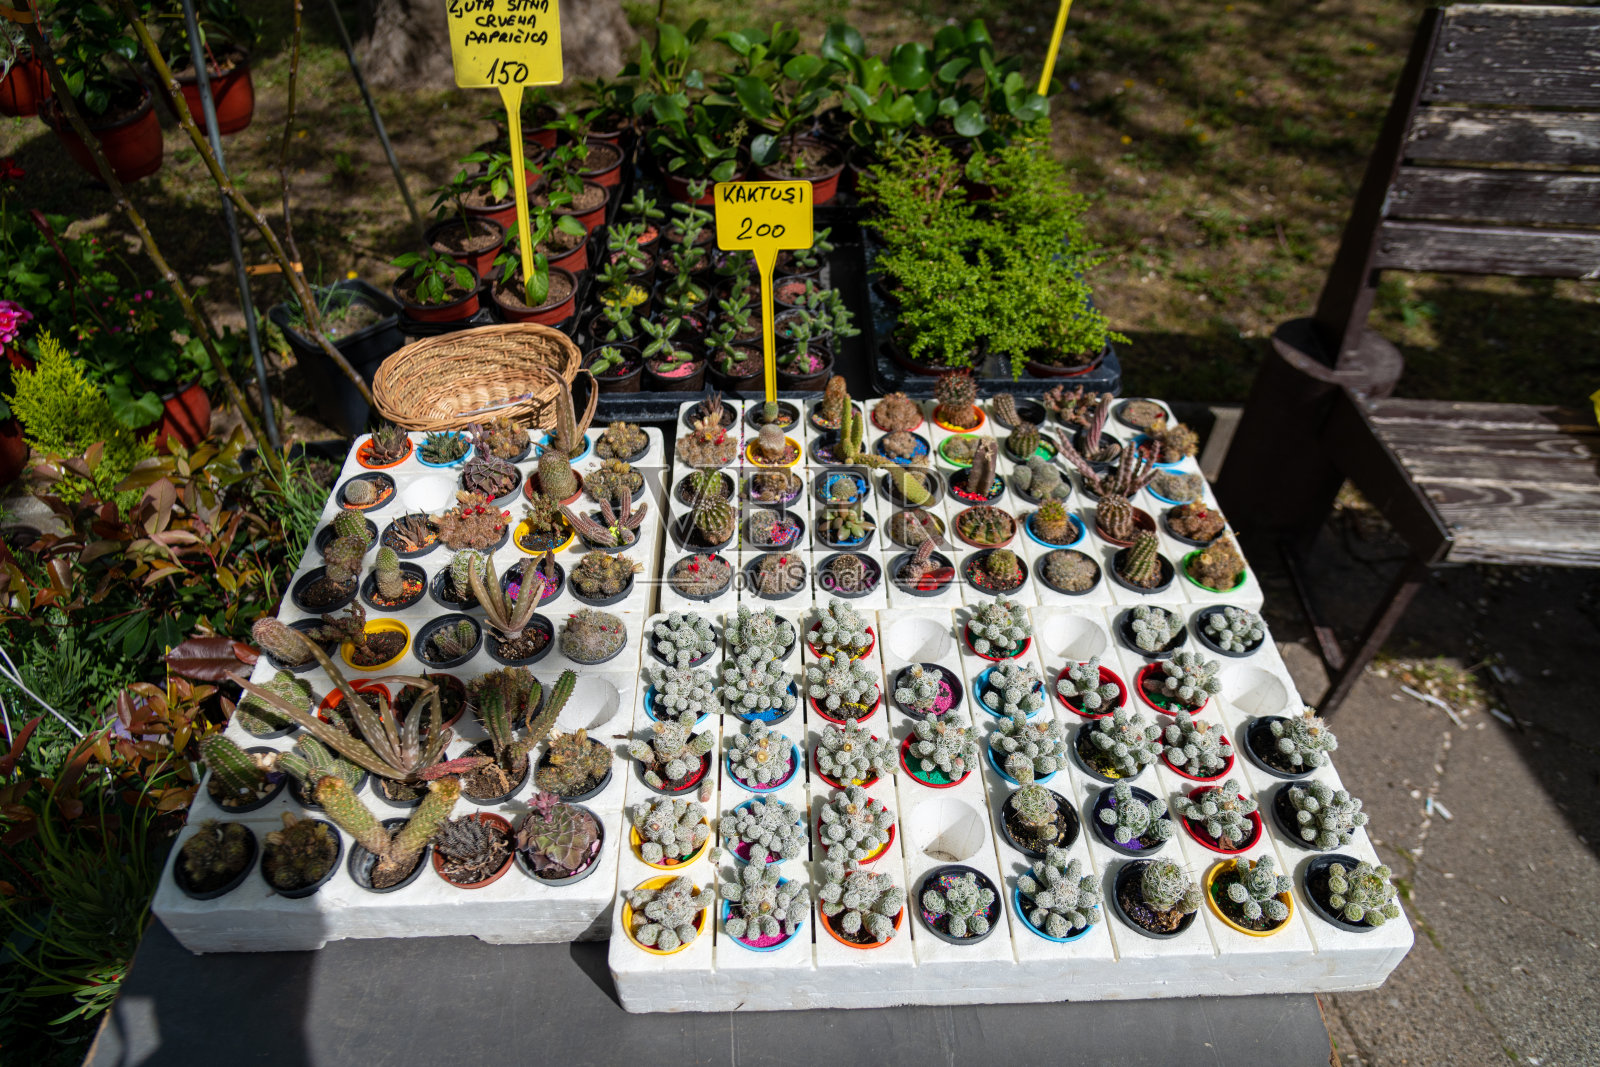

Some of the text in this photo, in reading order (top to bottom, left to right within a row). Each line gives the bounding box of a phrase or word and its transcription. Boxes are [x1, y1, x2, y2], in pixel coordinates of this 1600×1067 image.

[475, 14, 537, 29] CRVENA
[486, 58, 529, 84] 150
[723, 184, 803, 204] KAKTUSI
[736, 217, 786, 241] 200
